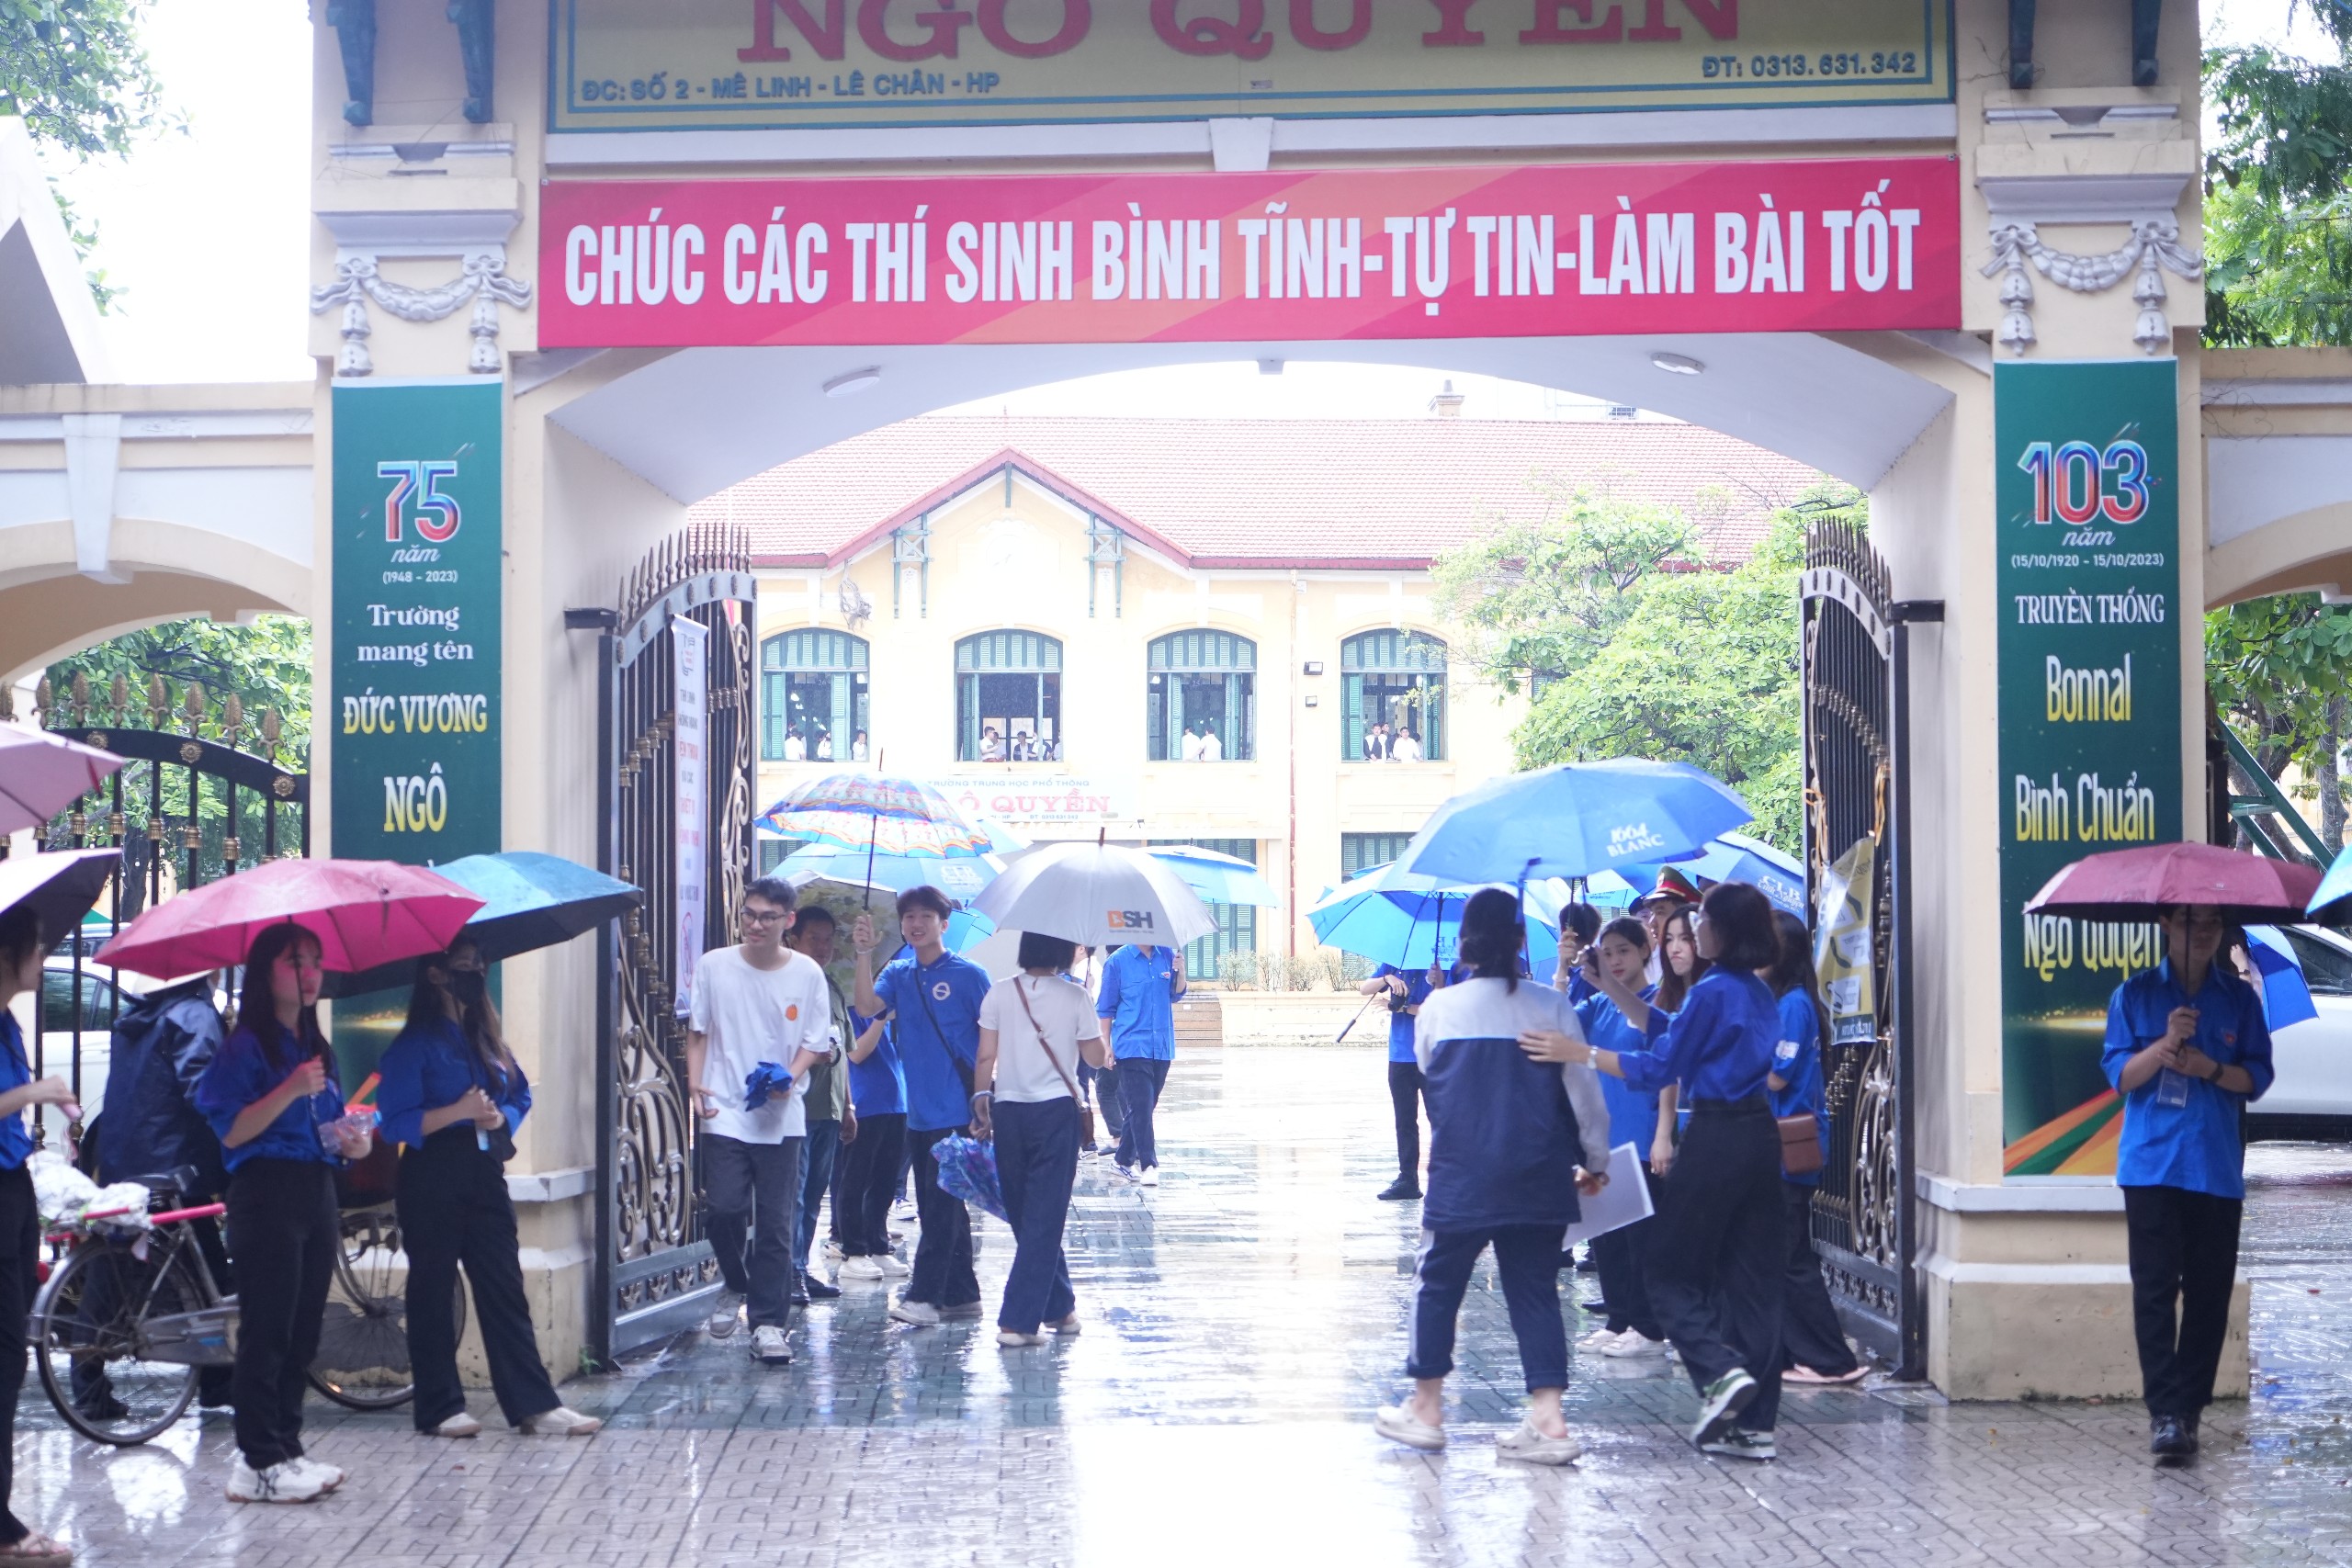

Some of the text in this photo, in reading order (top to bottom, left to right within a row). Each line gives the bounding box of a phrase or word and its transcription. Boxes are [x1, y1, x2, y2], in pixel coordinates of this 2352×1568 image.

[1702, 56, 1743, 78] ĐT:
[630, 71, 668, 100] SỐ
[675, 79, 689, 99] 2
[712, 72, 747, 98] MÊ
[756, 74, 811, 97] LINH
[834, 69, 865, 96] LÊ
[874, 68, 944, 95] CHÂN
[967, 72, 1001, 93] HP
[565, 208, 706, 306] CHÚC
[723, 207, 829, 305] CÁC
[844, 204, 928, 304] THÍ
[944, 220, 1073, 304] SINH
[1091, 202, 1220, 302] BÌNH
[1714, 193, 1804, 294] BÀI
[1823, 179, 1920, 292] TỐT
[2017, 440, 2150, 525] 103
[378, 460, 461, 542] 75
[2062, 529, 2116, 547] năm
[390, 544, 441, 563] năm
[2011, 554, 2080, 568] (15/10/1920
[2093, 553, 2165, 568] 15/10/2023)
[382, 570, 413, 584] (1948
[425, 570, 458, 583] 2023)
[367, 604, 459, 631] Trường
[2015, 586, 2165, 624] TRUYỀN THỐNG
[357, 641, 474, 667] mang tên
[2046, 652, 2131, 722] Bonnal
[343, 687, 488, 734] ĐỨC VƯƠNG
[1010, 780, 1030, 788] HỌC
[1056, 778, 1090, 787] THÔNG
[383, 761, 447, 833] NGÔ
[990, 787, 1111, 814] QUYỀN
[2015, 771, 2154, 842] Bình Chuẩn
[1606, 833, 1666, 858] BLANC
[1107, 910, 1154, 929] BSH
